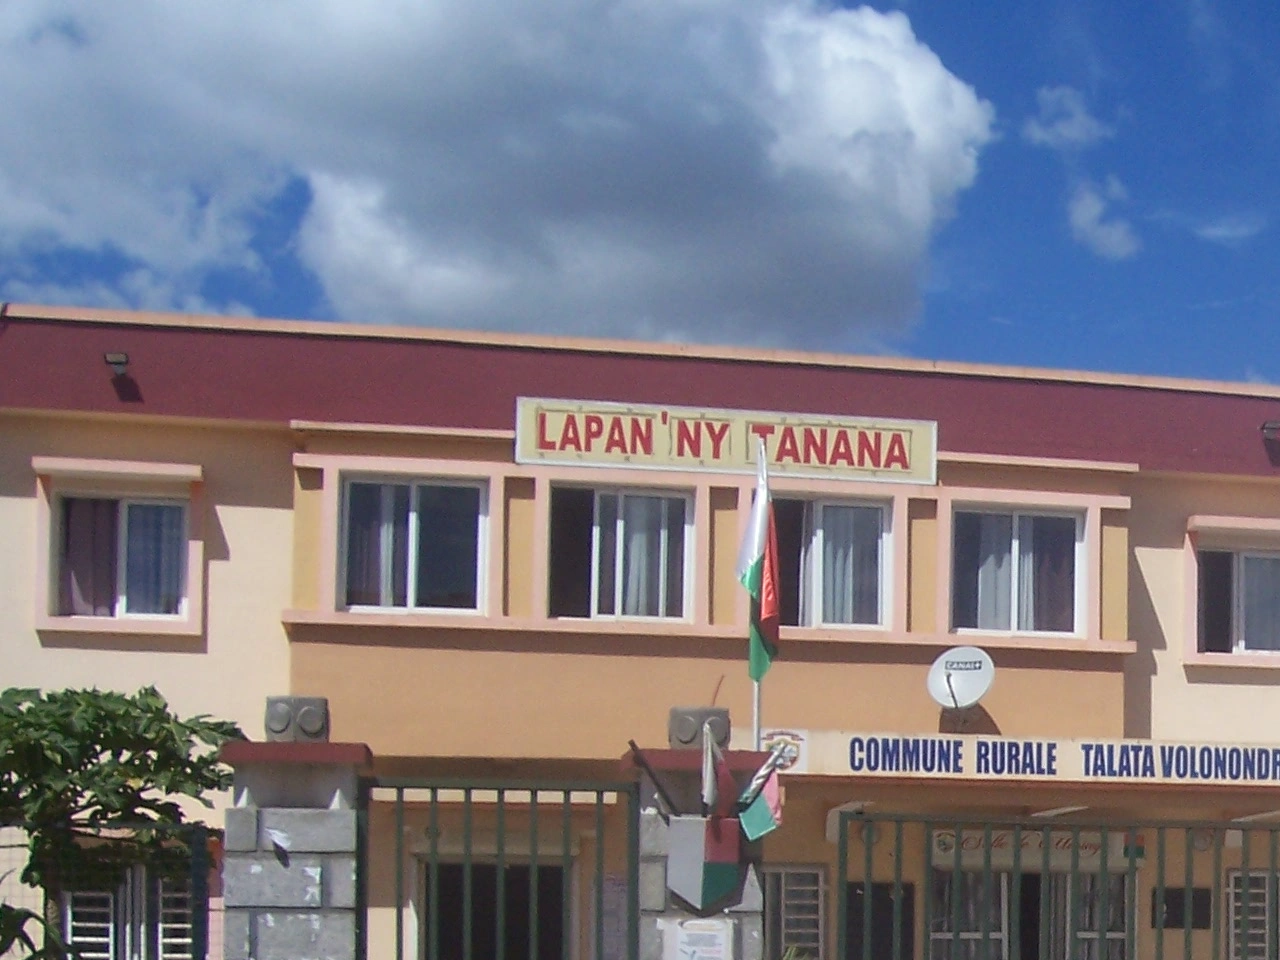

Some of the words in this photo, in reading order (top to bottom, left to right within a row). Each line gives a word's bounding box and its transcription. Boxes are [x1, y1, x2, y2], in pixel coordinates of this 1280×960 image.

[752, 423, 909, 469] TANANA
[946, 661, 982, 670] CANAL+
[850, 737, 963, 772] COMMUNE
[976, 741, 1057, 775] RURALE
[1081, 744, 1155, 777] TALATA
